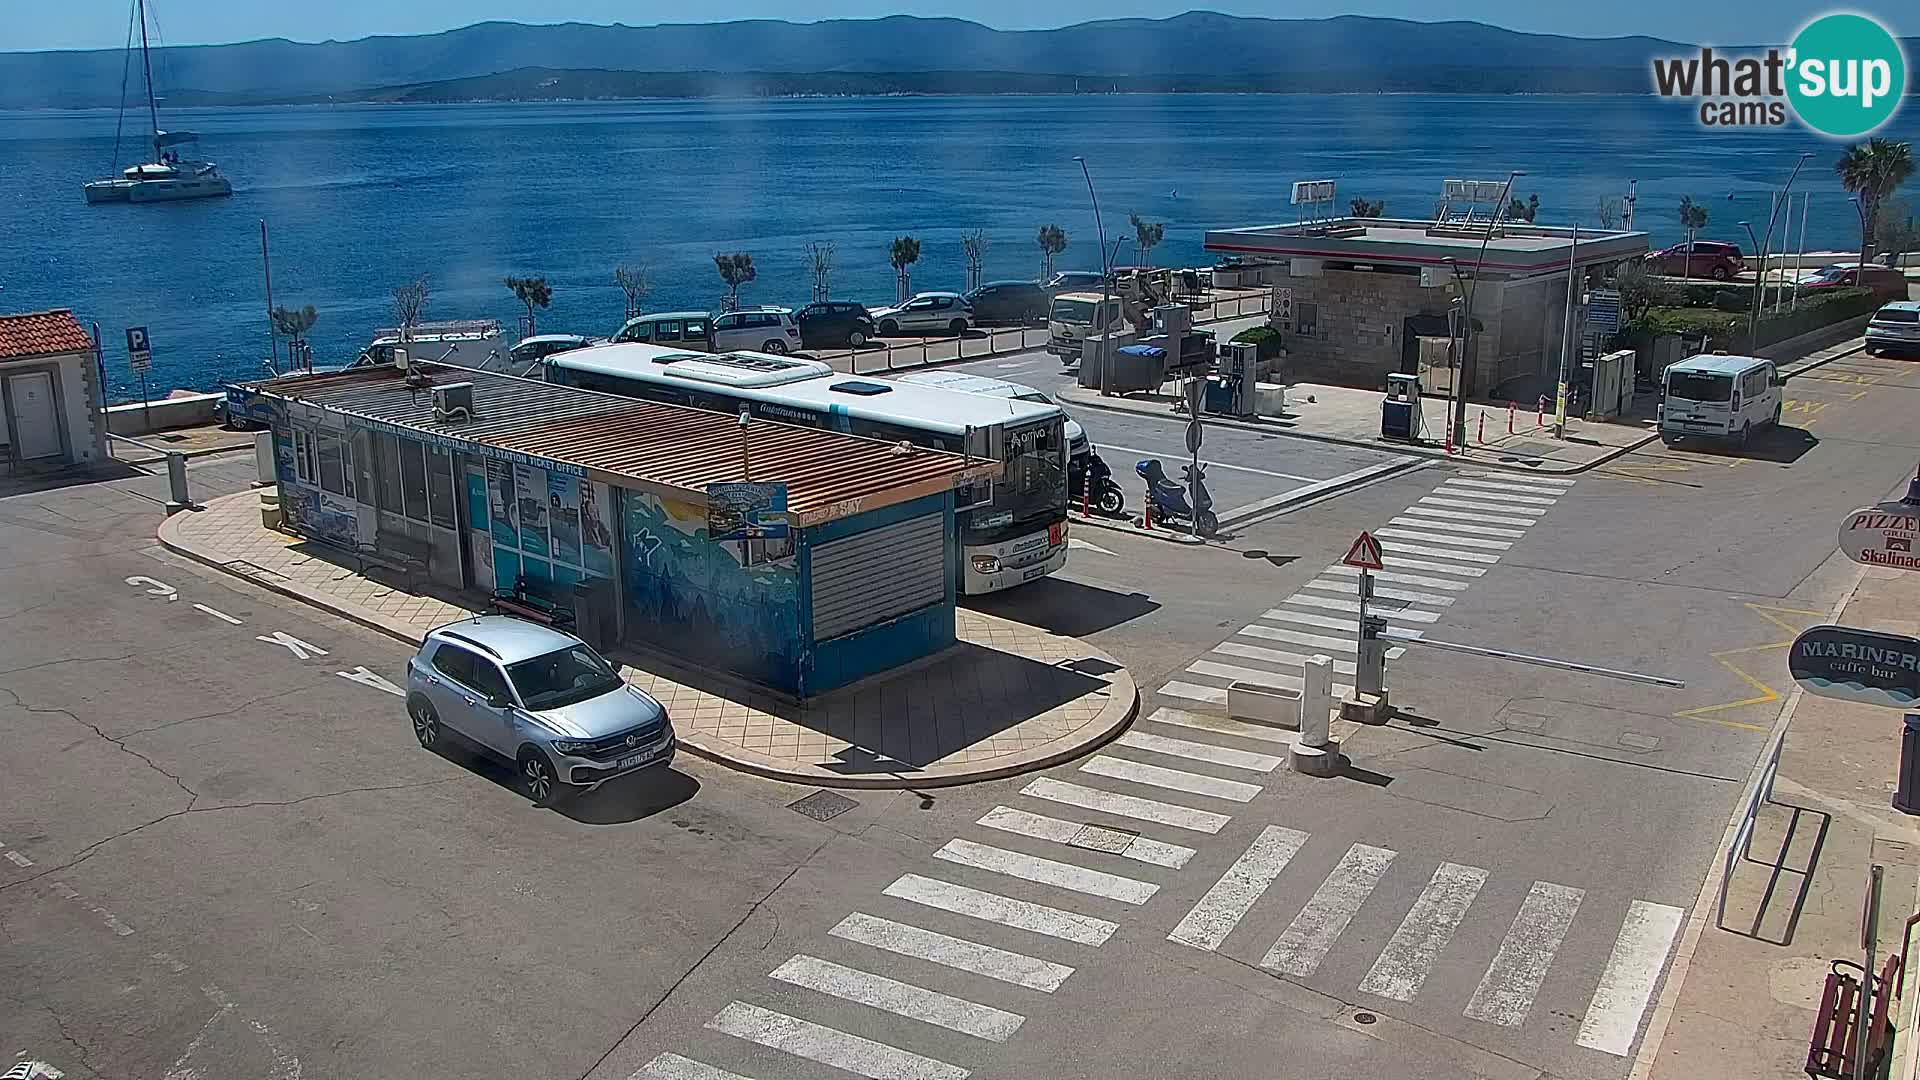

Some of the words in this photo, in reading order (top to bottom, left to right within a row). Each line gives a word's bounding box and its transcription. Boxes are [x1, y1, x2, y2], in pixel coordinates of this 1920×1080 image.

[131, 330, 144, 348] P
[1021, 427, 1046, 443] arriva
[438, 436, 468, 450] POSTAJA
[480, 445, 494, 457] BUS
[495, 448, 527, 464] STATION
[530, 456, 555, 470] TICKET
[557, 462, 583, 476] OFFICE
[1829, 661, 1866, 674] caffe
[1871, 664, 1897, 680] bar
